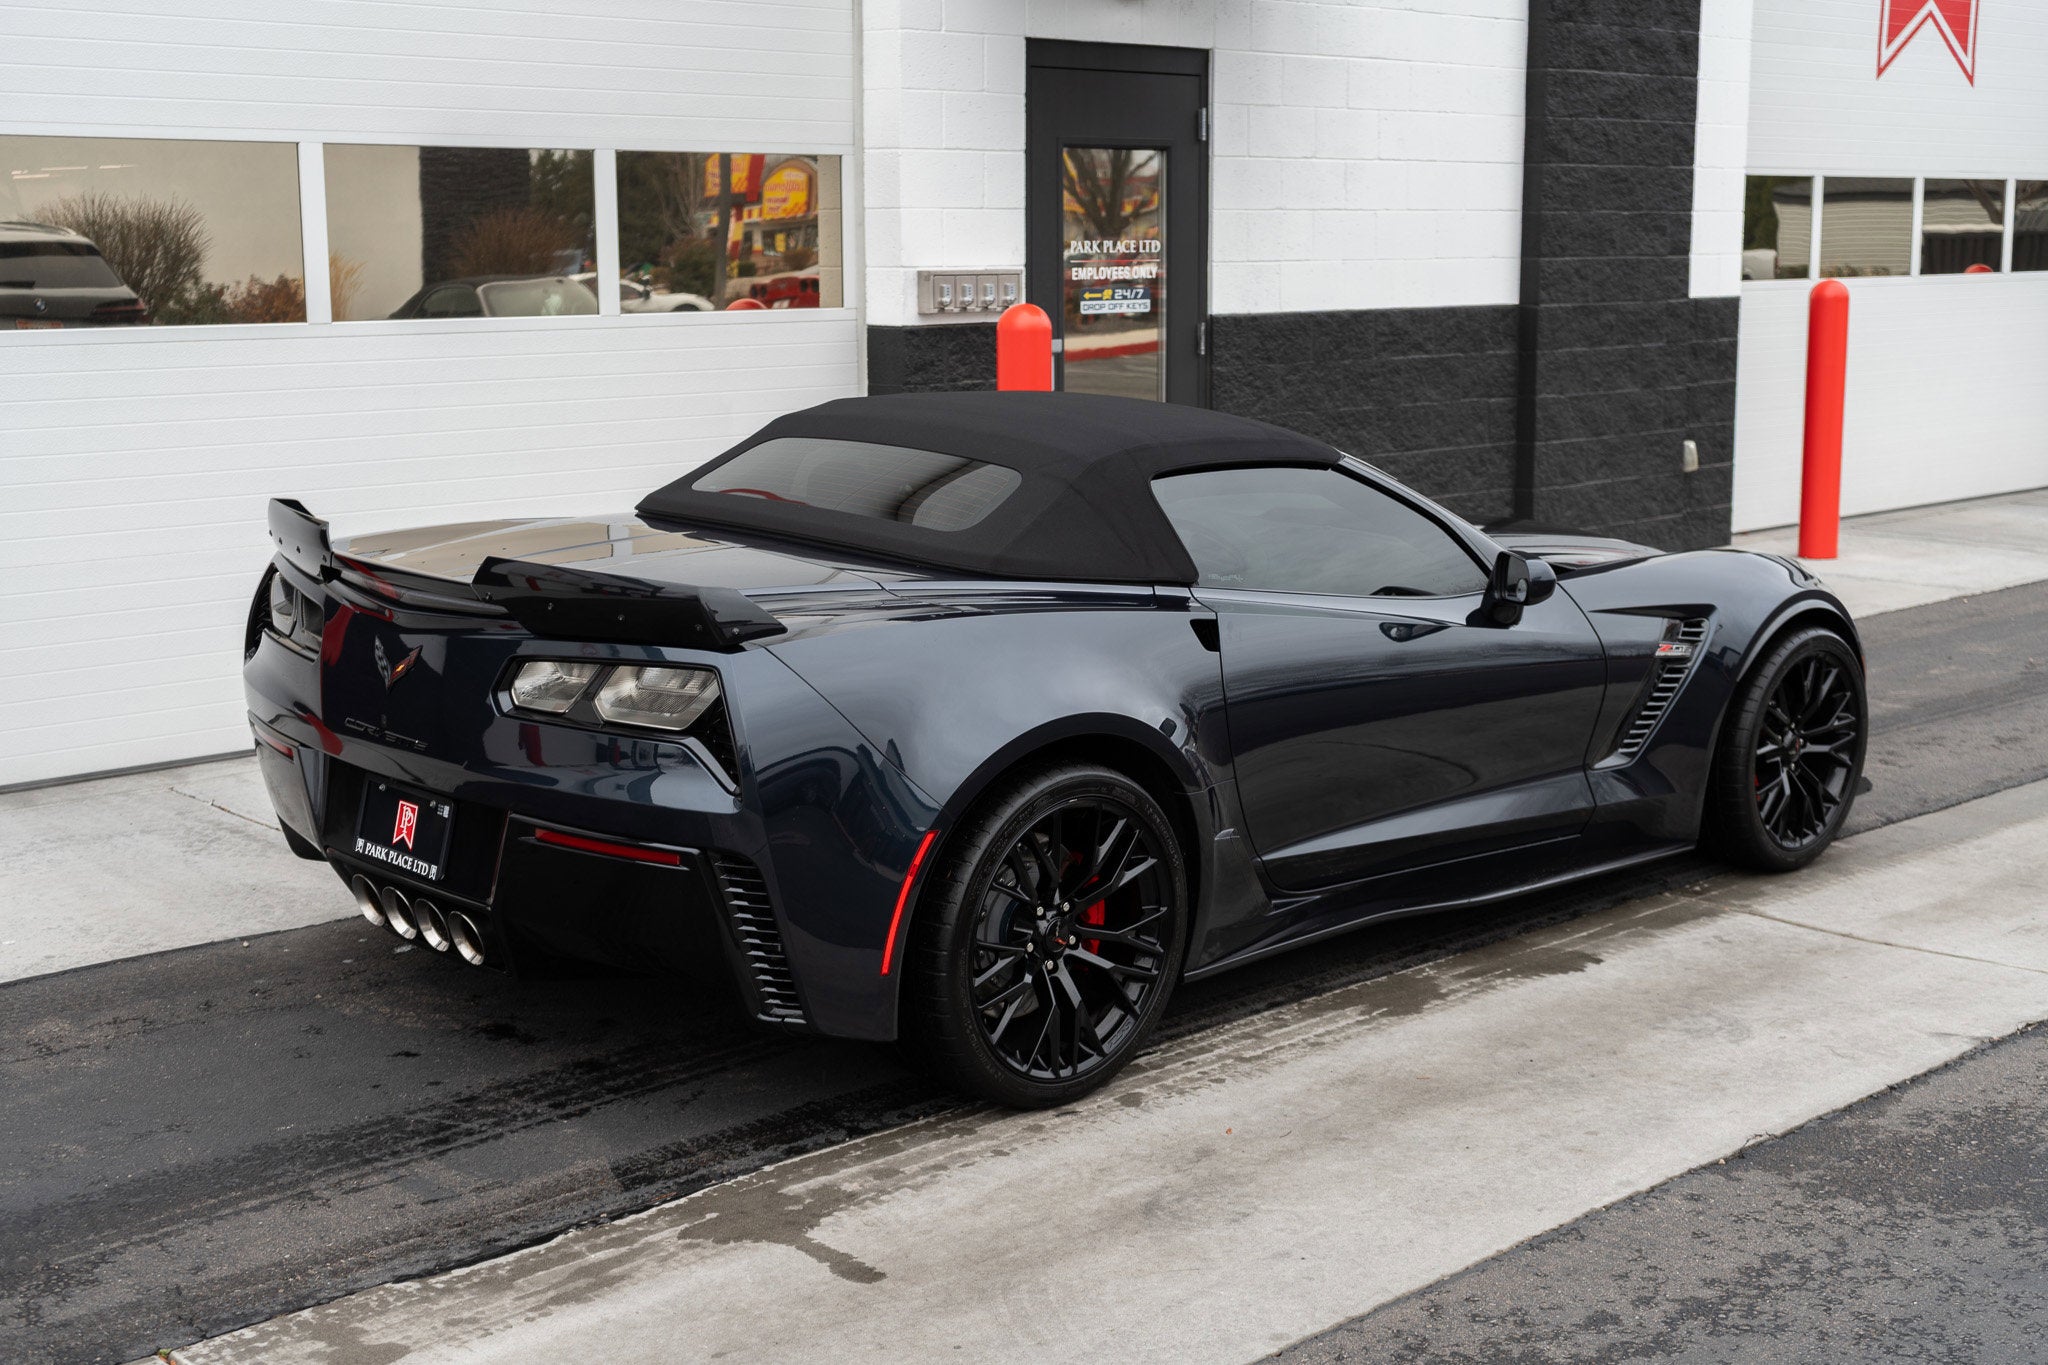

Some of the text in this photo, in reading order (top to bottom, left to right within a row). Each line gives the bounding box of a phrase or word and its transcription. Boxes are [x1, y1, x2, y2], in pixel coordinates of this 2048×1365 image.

[1070, 239, 1161, 254] PARK PLACE LTD
[1071, 265, 1158, 280] EMPLOYEES ONLY
[1114, 289, 1144, 299] 24/7
[1083, 303, 1106, 311] DROP
[1126, 302, 1148, 310] KEYS
[365, 842, 429, 876] PARK PLACE LTD
